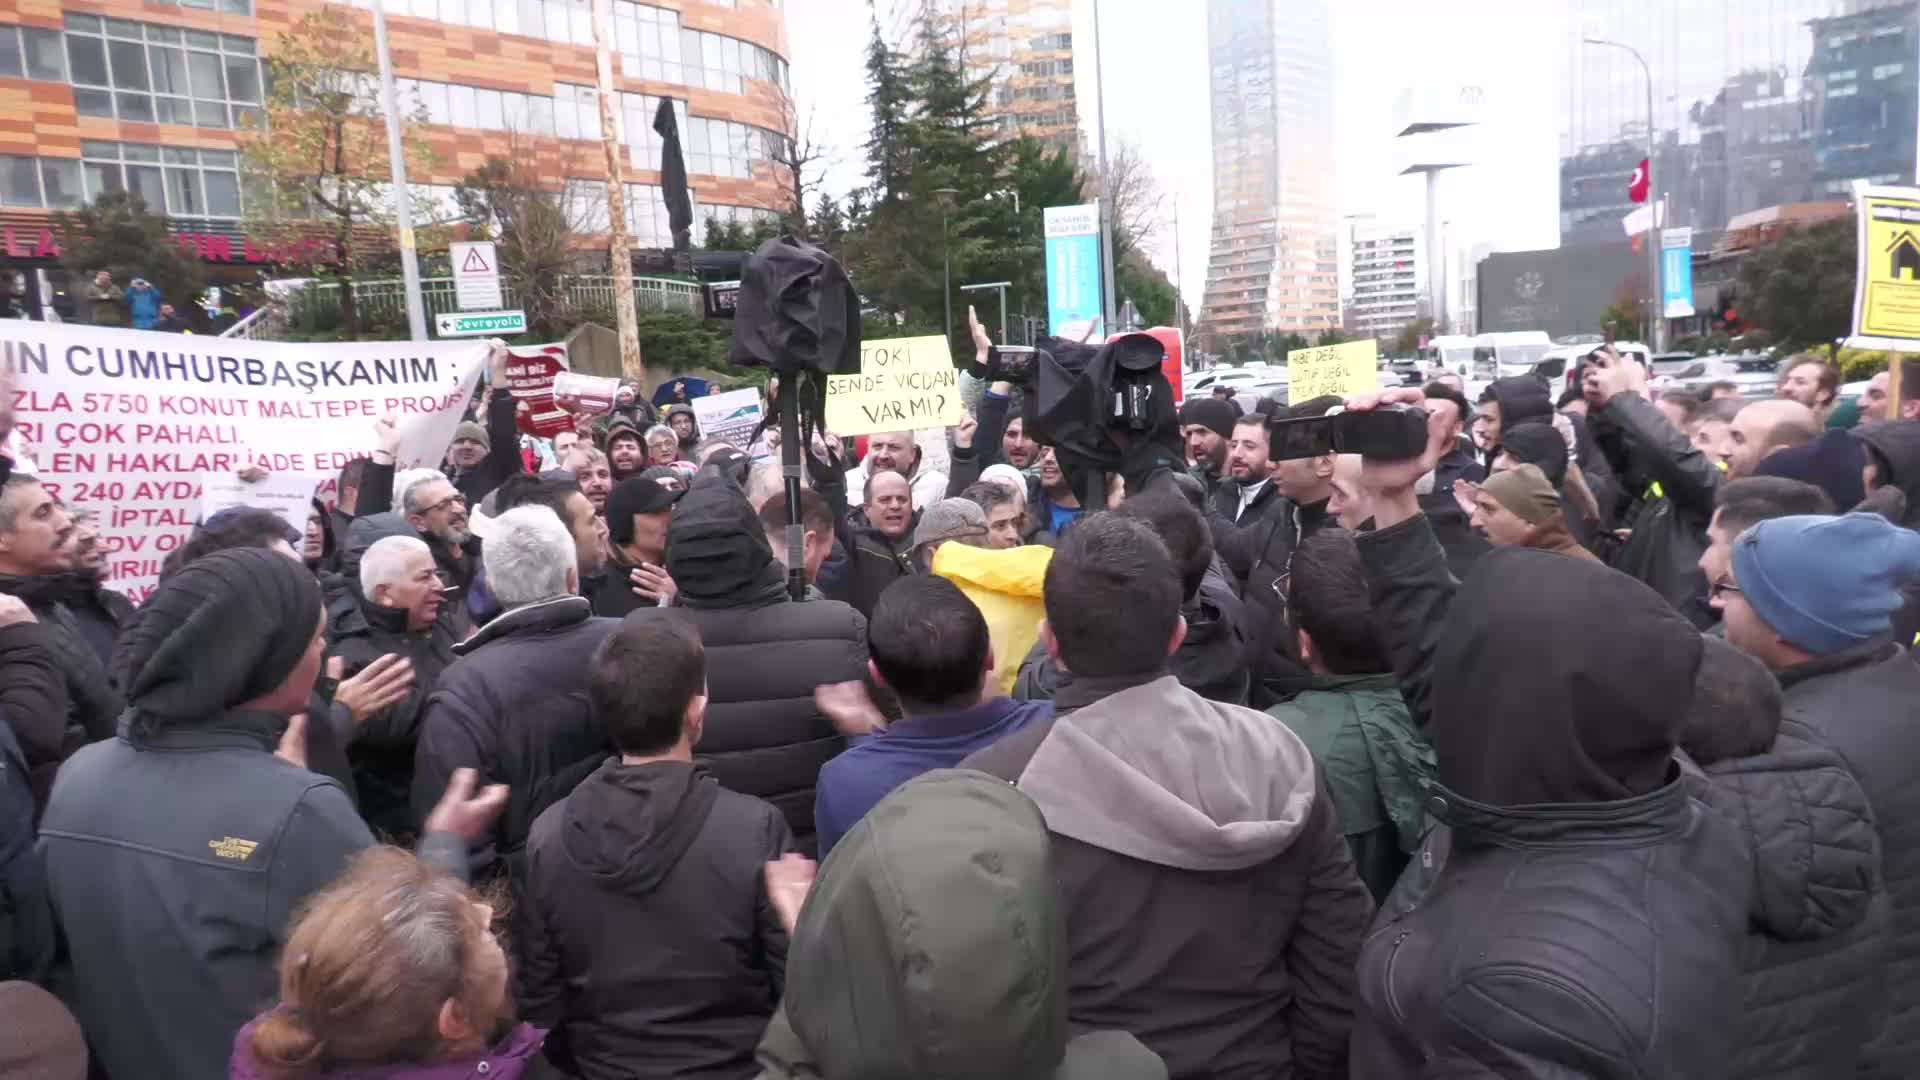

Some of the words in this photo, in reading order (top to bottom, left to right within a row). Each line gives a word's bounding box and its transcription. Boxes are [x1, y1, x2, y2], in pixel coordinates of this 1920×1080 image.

[455, 316, 522, 331] Çevreyolu
[65, 344, 439, 394] CUMHURBAŞKANIM
[827, 374, 885, 395] SENDE
[82, 392, 149, 414] 5750
[159, 395, 249, 417] KONUT
[257, 398, 377, 418] MALTEPE
[861, 399, 907, 425] VAR
[55, 422, 126, 448] ÇOK
[136, 424, 246, 445] PAHALI.
[71, 482, 125, 502] 240
[111, 505, 194, 529] İPTAL
